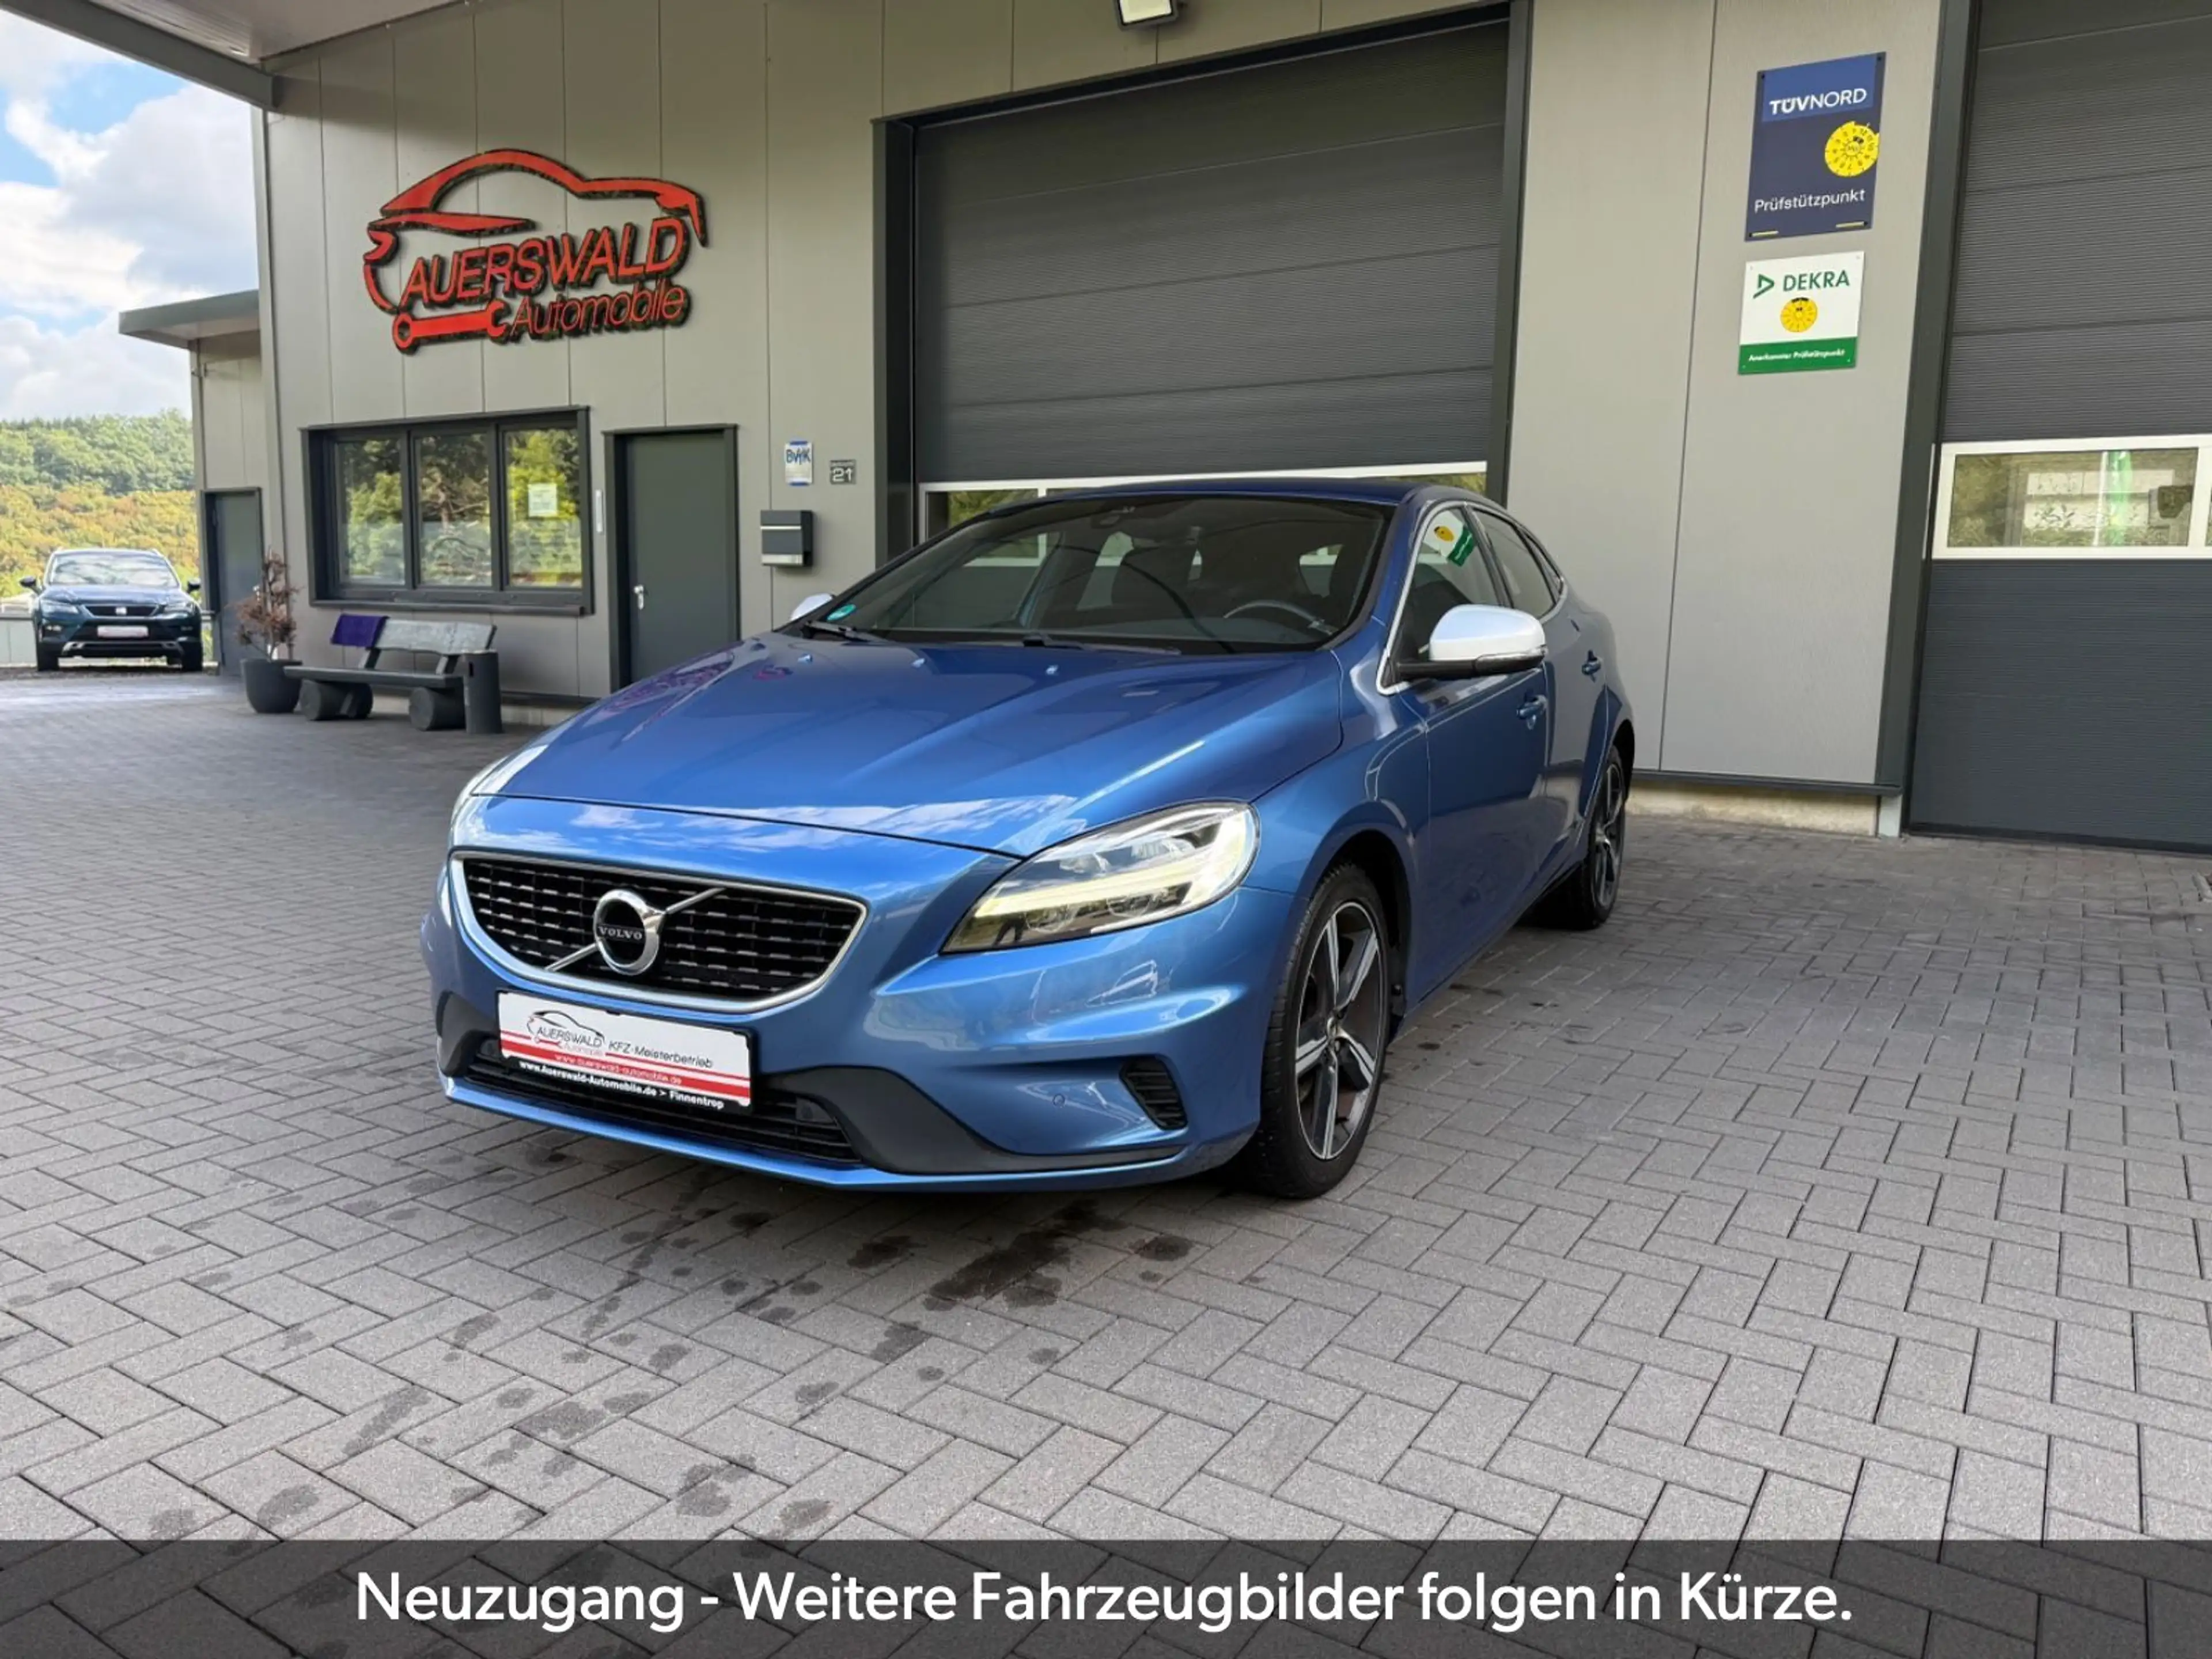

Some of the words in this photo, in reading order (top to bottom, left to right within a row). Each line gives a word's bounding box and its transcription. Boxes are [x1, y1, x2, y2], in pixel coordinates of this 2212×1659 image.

[1754, 189, 1865, 214] Prüfstützpunkt
[401, 217, 690, 308] AUERSWALD
[1783, 270, 1850, 291] DEKRA
[510, 279, 688, 337] Automobile
[833, 468, 852, 482] 21
[598, 926, 643, 940] VOLVO
[537, 1026, 603, 1048] AUERSWALD
[520, 1060, 657, 1097] www.Auerswald-Automobile.de
[669, 1090, 725, 1110] Finnentrop
